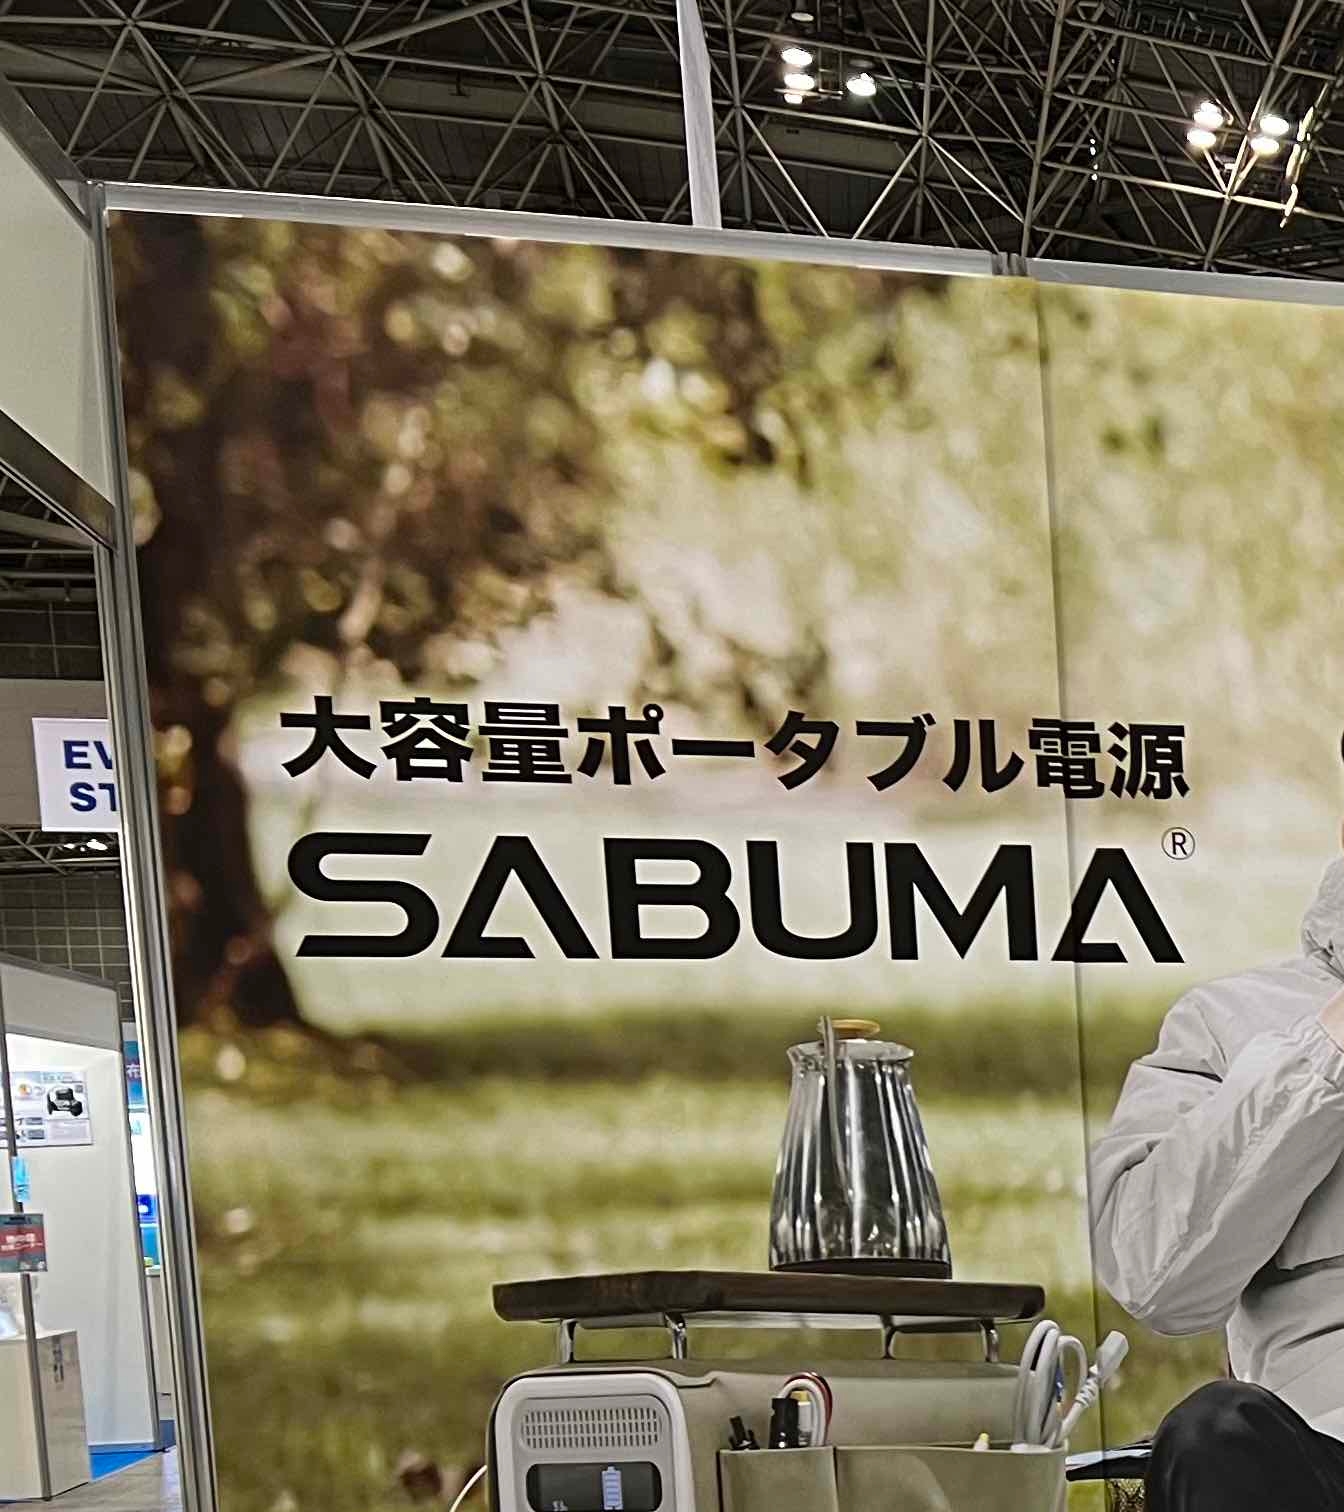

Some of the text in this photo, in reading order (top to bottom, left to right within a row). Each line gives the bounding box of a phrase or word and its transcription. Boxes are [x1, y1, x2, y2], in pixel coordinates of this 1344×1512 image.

[279, 694, 1190, 799] 大容量ポータブル電源
[287, 831, 1185, 963] SABUMA
